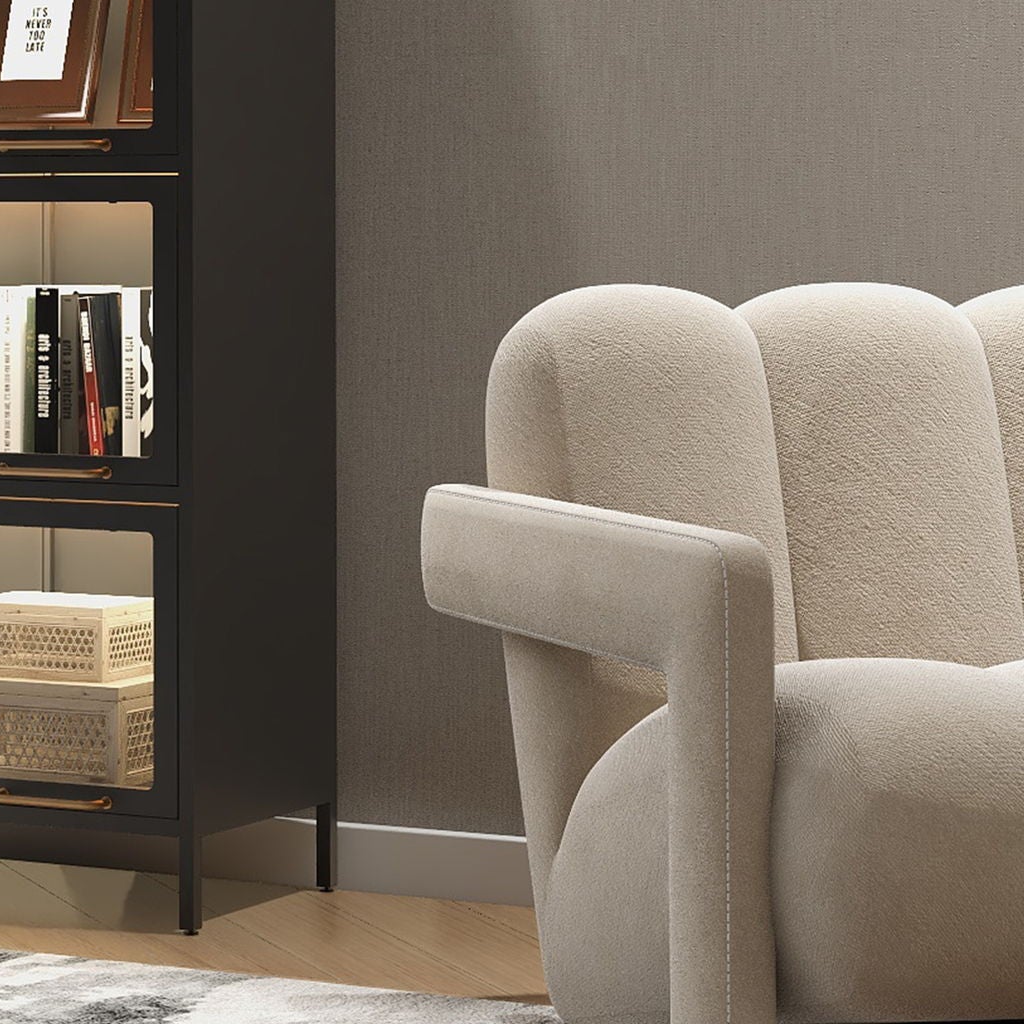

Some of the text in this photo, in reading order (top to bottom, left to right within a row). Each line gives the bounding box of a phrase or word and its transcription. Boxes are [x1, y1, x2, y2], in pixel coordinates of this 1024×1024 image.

[25, 19, 52, 29] NEVER
[28, 30, 46, 41] TOO
[25, 41, 46, 53] LATE
[38, 333, 51, 352] arts
[83, 342, 93, 373] BAZAAR
[37, 365, 53, 418] architecture
[124, 367, 136, 419] architecture
